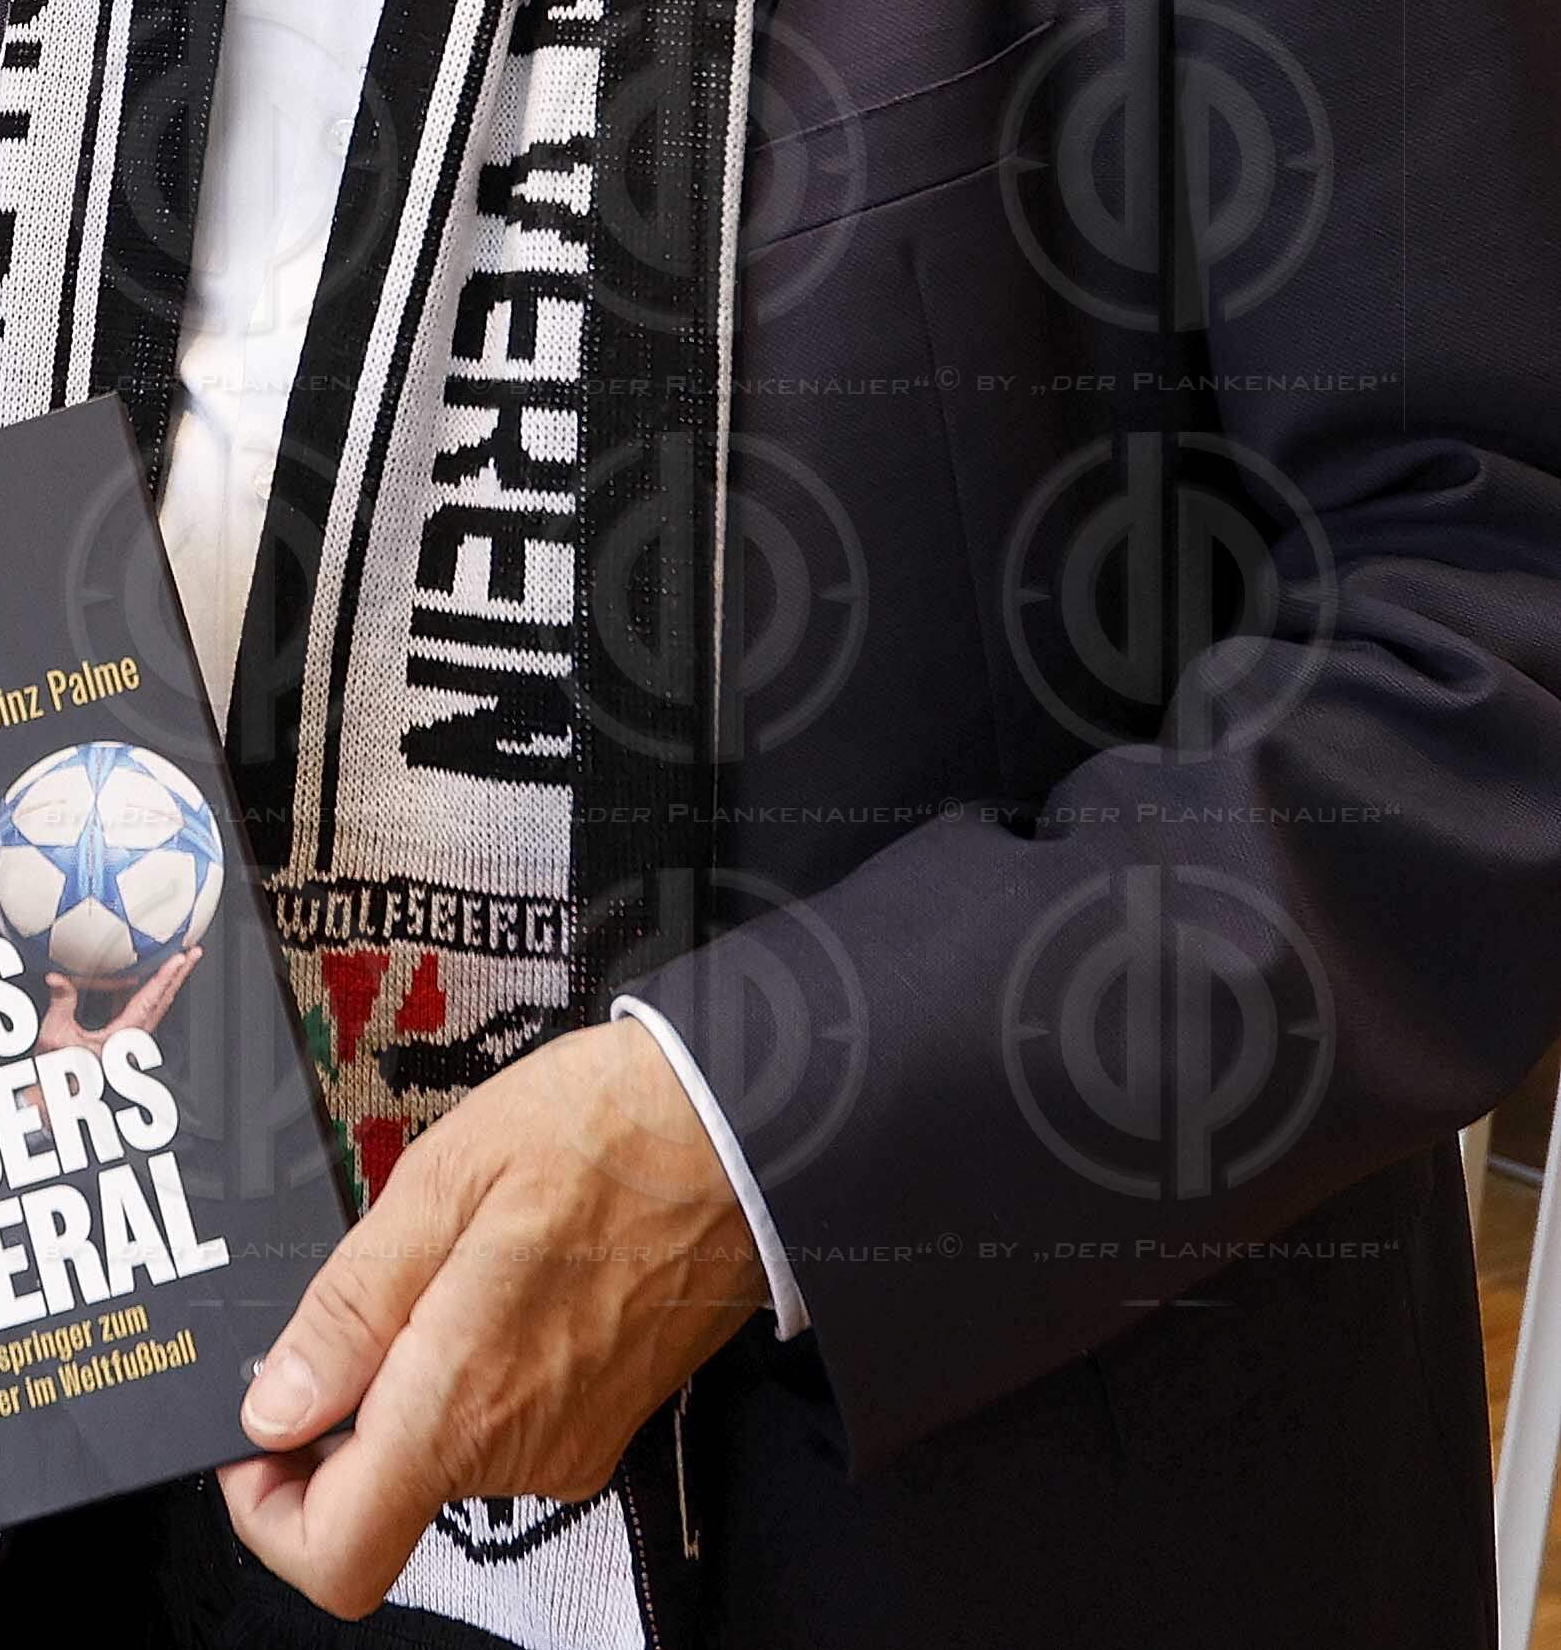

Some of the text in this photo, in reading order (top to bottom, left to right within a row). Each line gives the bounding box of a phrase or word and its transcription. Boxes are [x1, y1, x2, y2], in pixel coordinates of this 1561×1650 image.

[398, 134, 594, 787] VEREIN
[46, 656, 140, 711] Palme
[98, 1305, 148, 1343] zum
[25, 1375, 57, 1408] im
